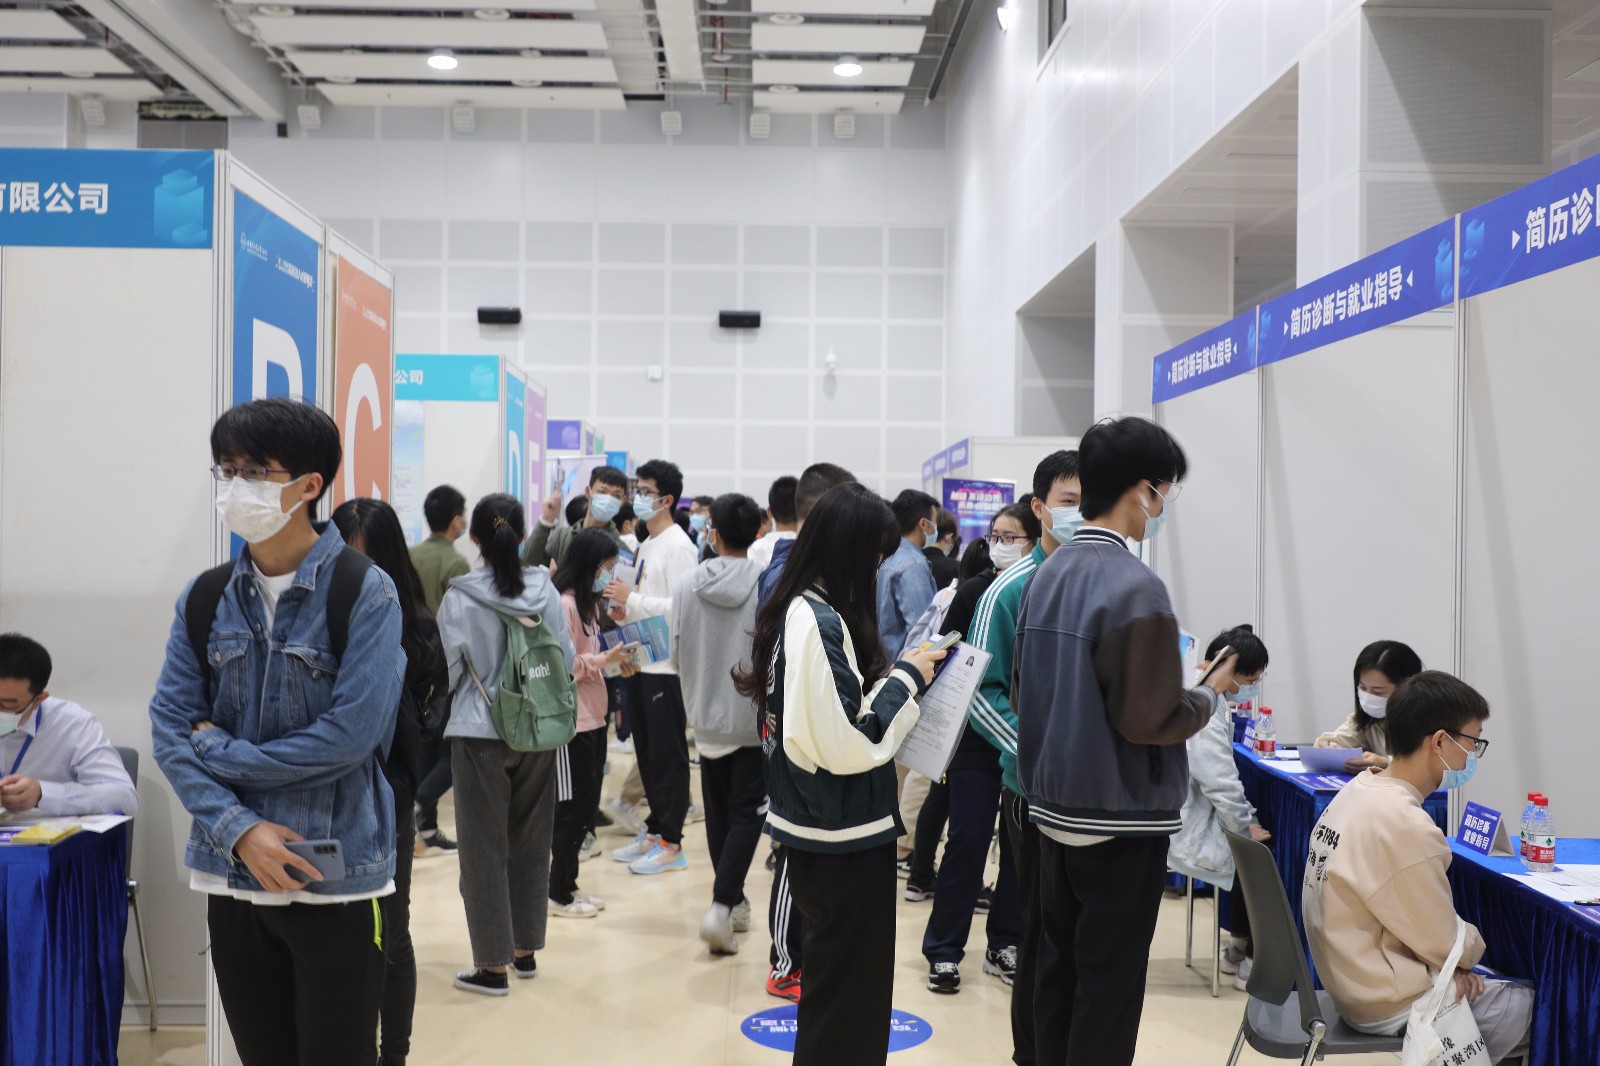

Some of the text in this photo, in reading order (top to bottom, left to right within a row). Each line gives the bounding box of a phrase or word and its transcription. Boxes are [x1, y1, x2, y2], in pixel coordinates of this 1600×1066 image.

[1526, 184, 1600, 254] 简历诊
[1290, 265, 1403, 340] 简历诊断与就业指导
[395, 369, 423, 385] 公司
[1171, 337, 1232, 386] 简历诊断与就业指导
[529, 661, 551, 681] eah!
